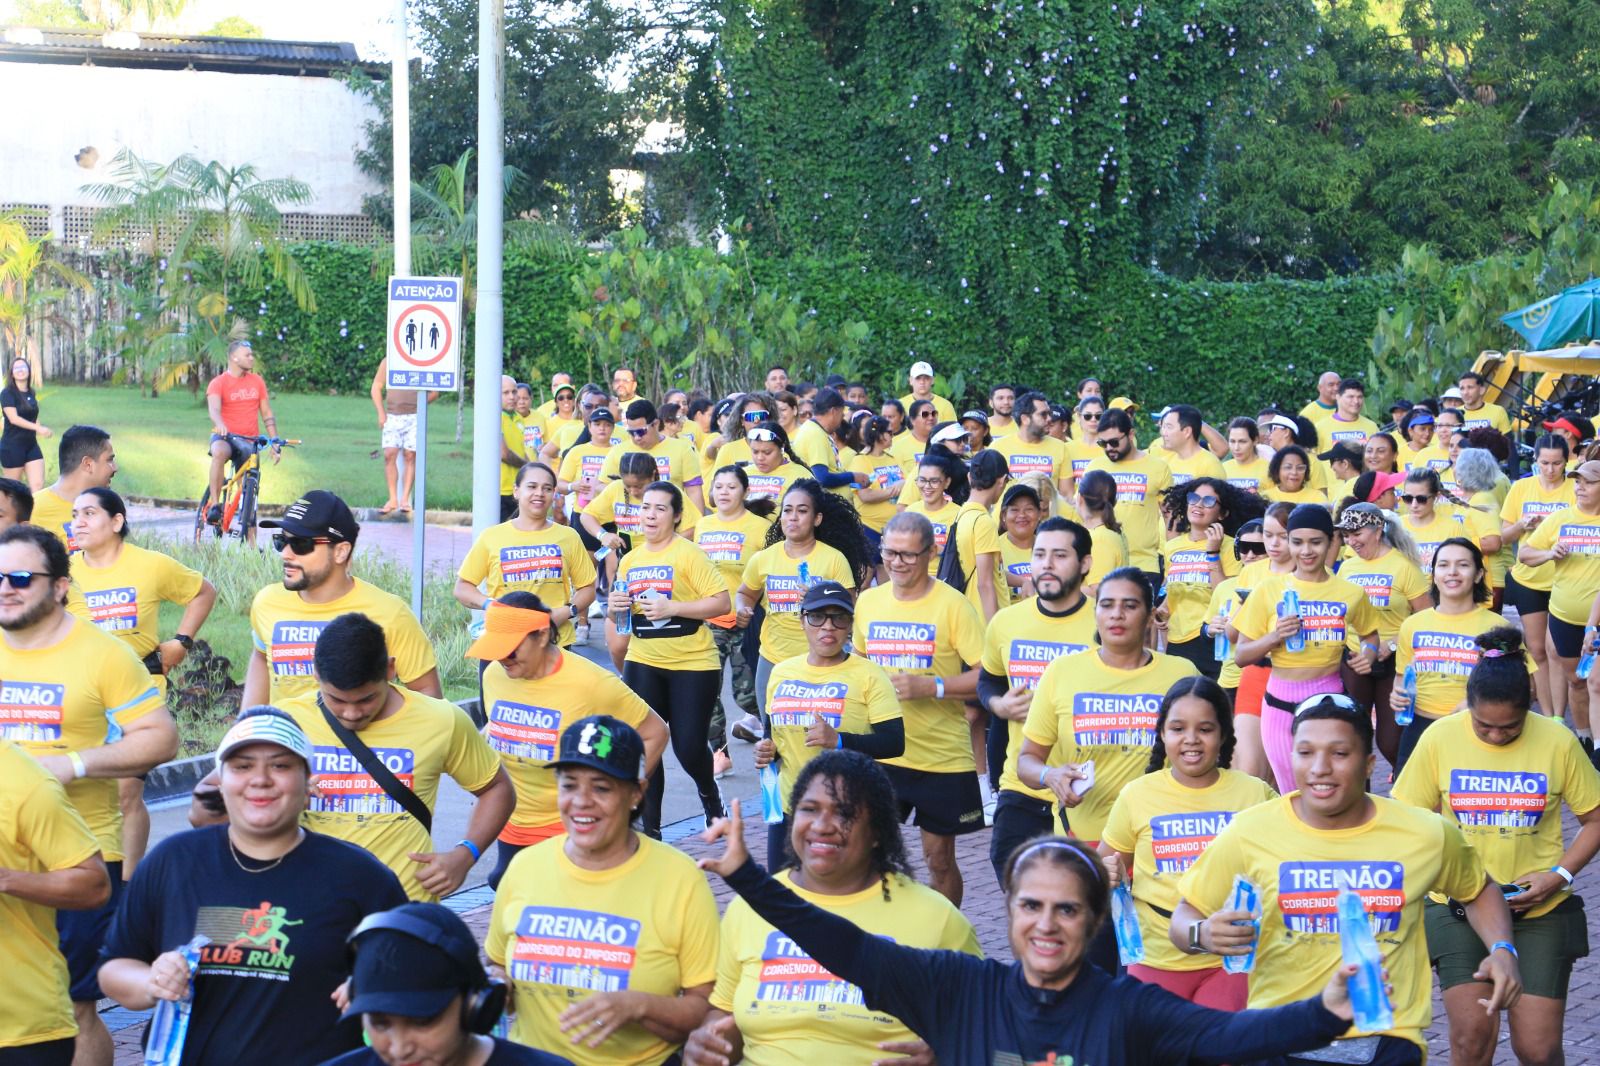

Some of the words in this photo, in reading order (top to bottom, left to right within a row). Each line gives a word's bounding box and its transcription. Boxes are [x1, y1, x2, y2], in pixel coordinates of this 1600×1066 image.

[395, 284, 453, 299] ATENÇÃO
[1014, 456, 1049, 465] TREINÃO
[1115, 475, 1143, 484] EINÃO
[702, 533, 739, 542] TREINÃO
[1565, 527, 1600, 537] TREINÃ
[505, 546, 557, 560] TREINÃO
[629, 567, 667, 580] TREINÃO
[769, 579, 800, 590] TREIN
[87, 591, 130, 609] EINÃO
[1300, 603, 1341, 616] EINÃO
[280, 626, 323, 642] TREIN
[873, 625, 929, 641] TREINÃO
[1418, 635, 1475, 650] TREINÃO
[0, 685, 55, 706] EINÃO
[780, 683, 839, 699] TREINÃO
[1082, 696, 1159, 713] TREINÃO
[497, 705, 554, 729] TREINÃO
[1075, 716, 1117, 729] CORRENDO
[1118, 716, 1130, 725] DO
[354, 779, 367, 789] DO
[1457, 774, 1539, 794] TREINÃO
[1451, 797, 1493, 807] CORRENDO
[1495, 797, 1508, 806] DO
[1509, 797, 1545, 807] IMPOSTO
[1159, 814, 1229, 837] TREINÃ
[1154, 841, 1199, 855] CORRENDO
[1281, 897, 1336, 909] CORRENDO
[1362, 895, 1402, 907] MPOSTO
[529, 913, 627, 946] TREINÃO
[201, 946, 244, 965] LUB
[247, 950, 296, 969] RUN
[566, 946, 582, 960] DO
[583, 948, 632, 964] IMPOSTO
[763, 962, 817, 977] CORRENDO
